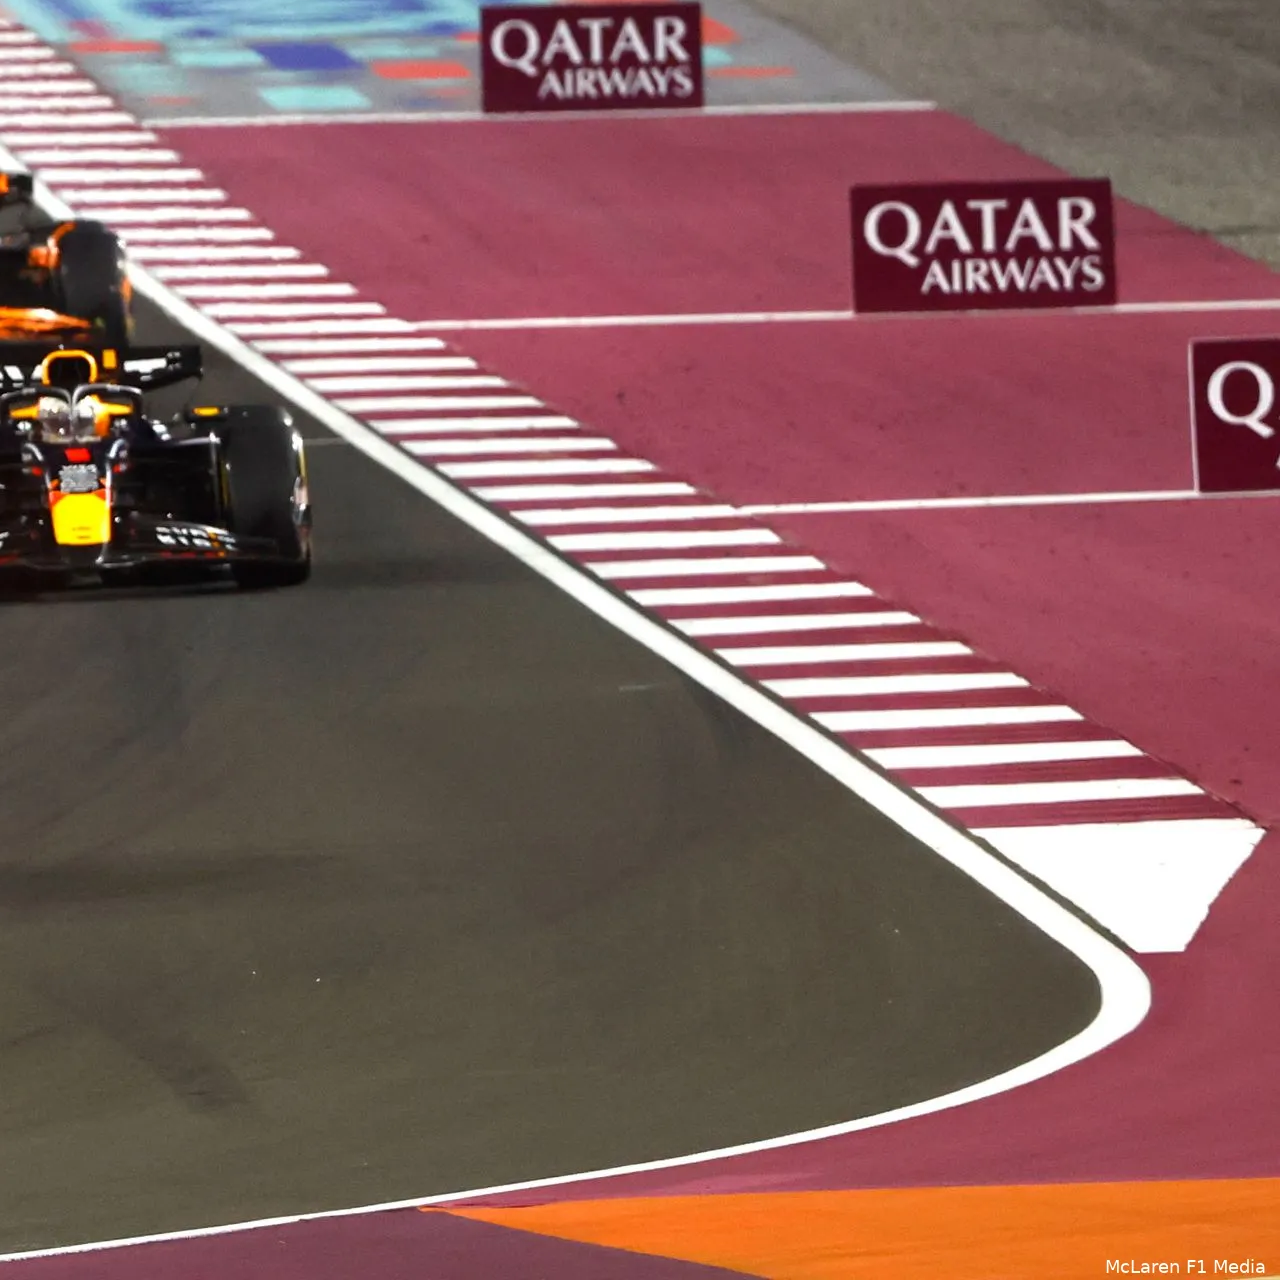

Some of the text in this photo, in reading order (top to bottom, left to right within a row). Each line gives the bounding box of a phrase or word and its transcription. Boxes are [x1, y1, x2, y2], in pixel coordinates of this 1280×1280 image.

[490, 16, 690, 76] QATAR
[538, 64, 694, 99] AIRWAYS
[864, 196, 1100, 266] QATAR
[921, 256, 1105, 293] AIRWAYS
[1206, 359, 1280, 439] Q
